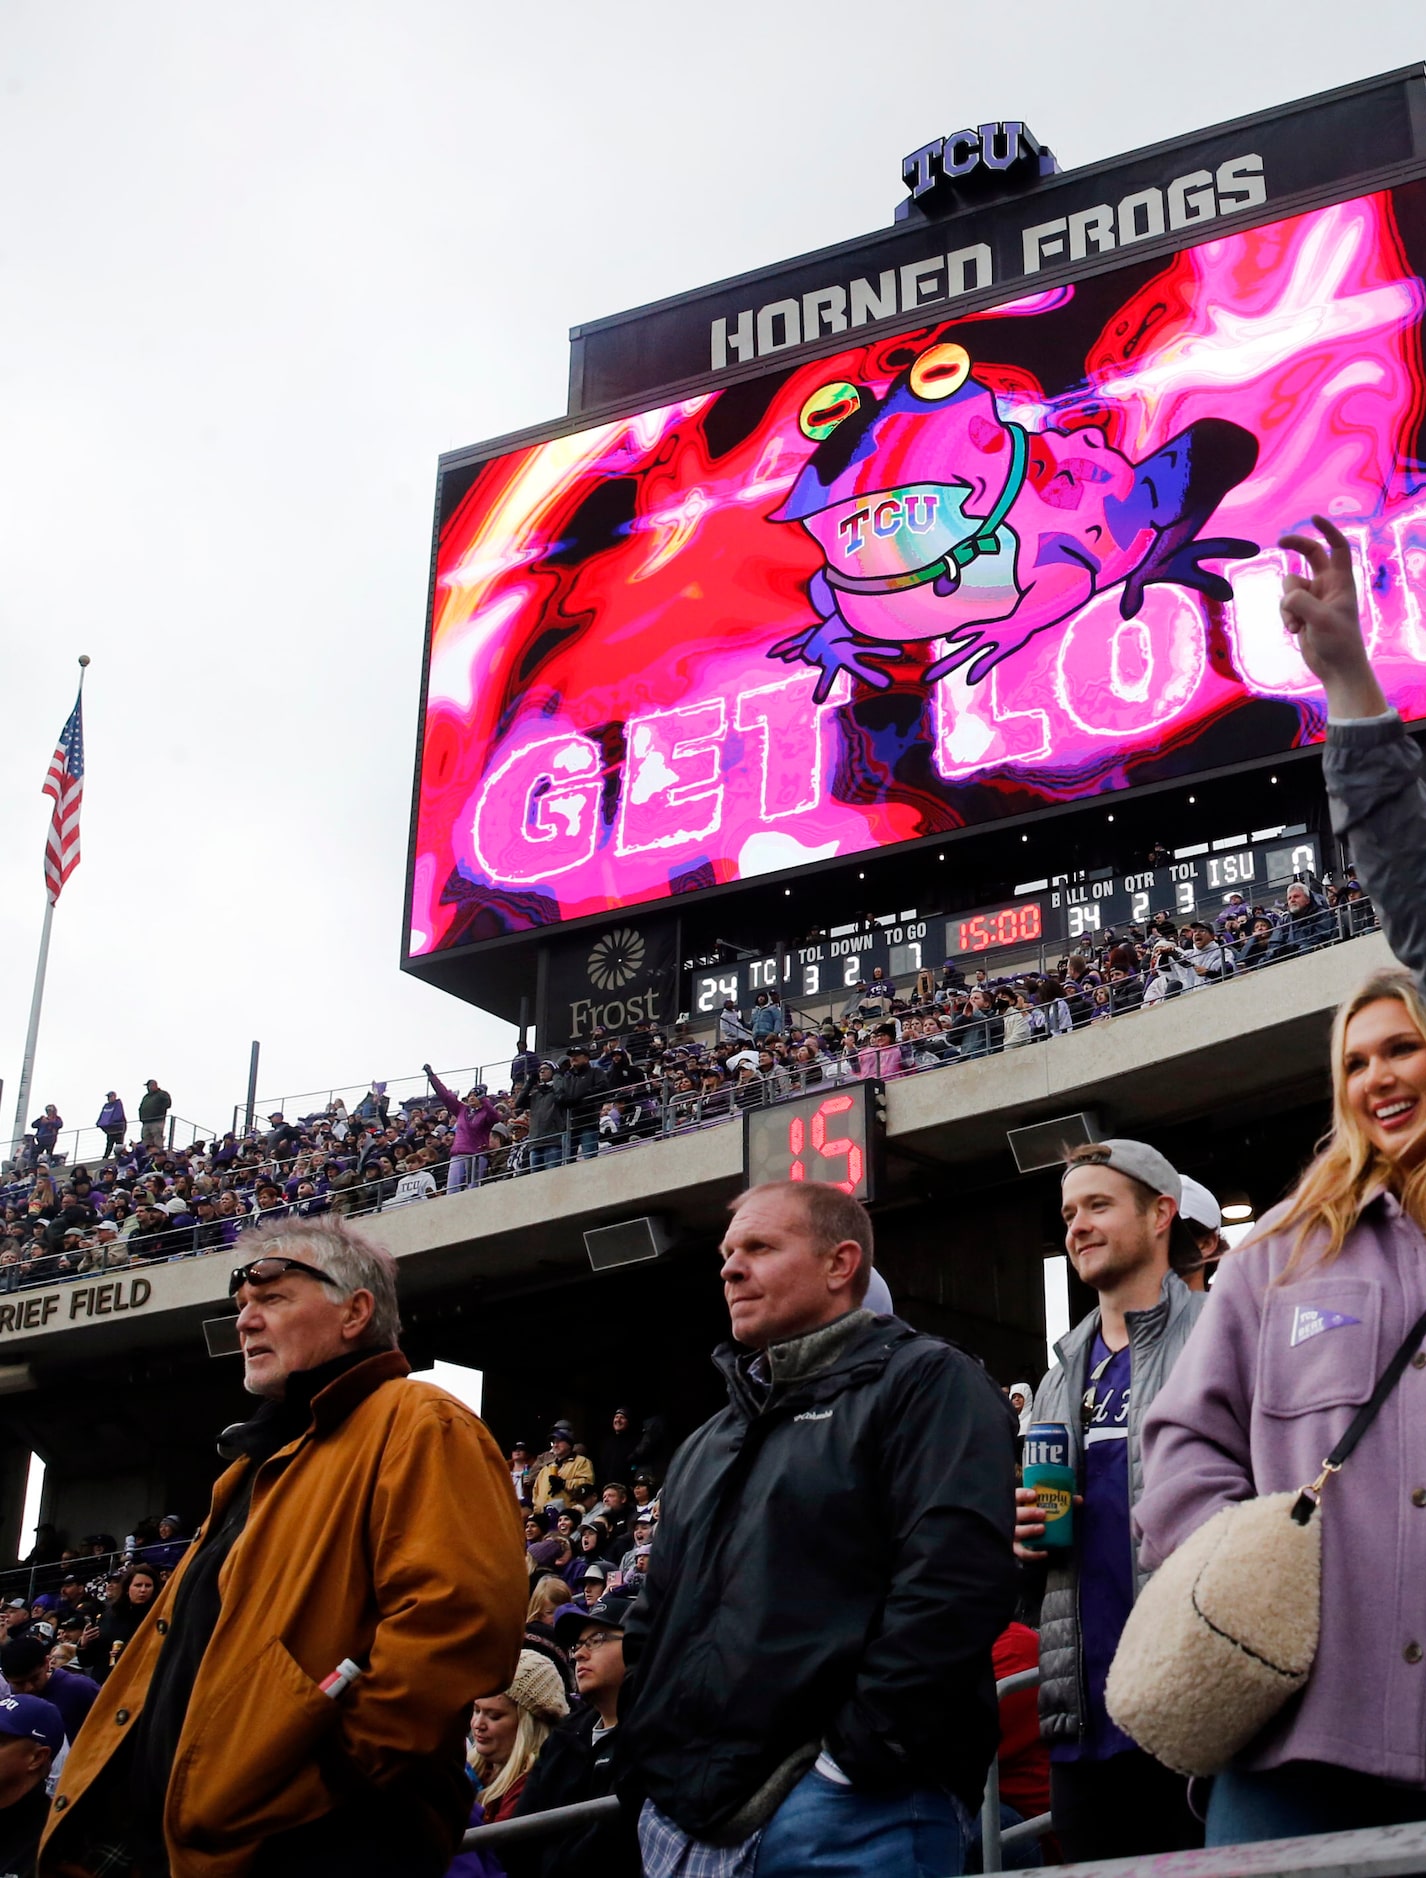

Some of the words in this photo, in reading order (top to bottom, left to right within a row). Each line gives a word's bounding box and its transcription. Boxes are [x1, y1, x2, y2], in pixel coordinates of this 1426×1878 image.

[904, 123, 1024, 198] TCU
[710, 242, 993, 370] HORNED
[1022, 153, 1267, 274] FROGS
[839, 494, 940, 558] TCU
[473, 668, 852, 883] GET
[1125, 871, 1155, 894] QTR
[1168, 862, 1199, 882] TOL
[1210, 851, 1254, 886] ISU
[1092, 880, 1113, 898] ON
[1179, 882, 1194, 914] 3
[1070, 904, 1101, 938] 34
[1133, 892, 1149, 923] 2
[885, 929, 903, 945] TO
[907, 922, 927, 940] GO
[959, 903, 1040, 951] 15:00
[799, 944, 825, 965] TOL
[830, 934, 873, 958] DOWN
[908, 942, 922, 969] 7
[806, 965, 819, 995] 3
[844, 956, 860, 987] 2
[698, 975, 738, 1012] 24
[569, 987, 661, 1039] Frost
[789, 1095, 863, 1194] 15
[69, 1278, 151, 1319] FIELD
